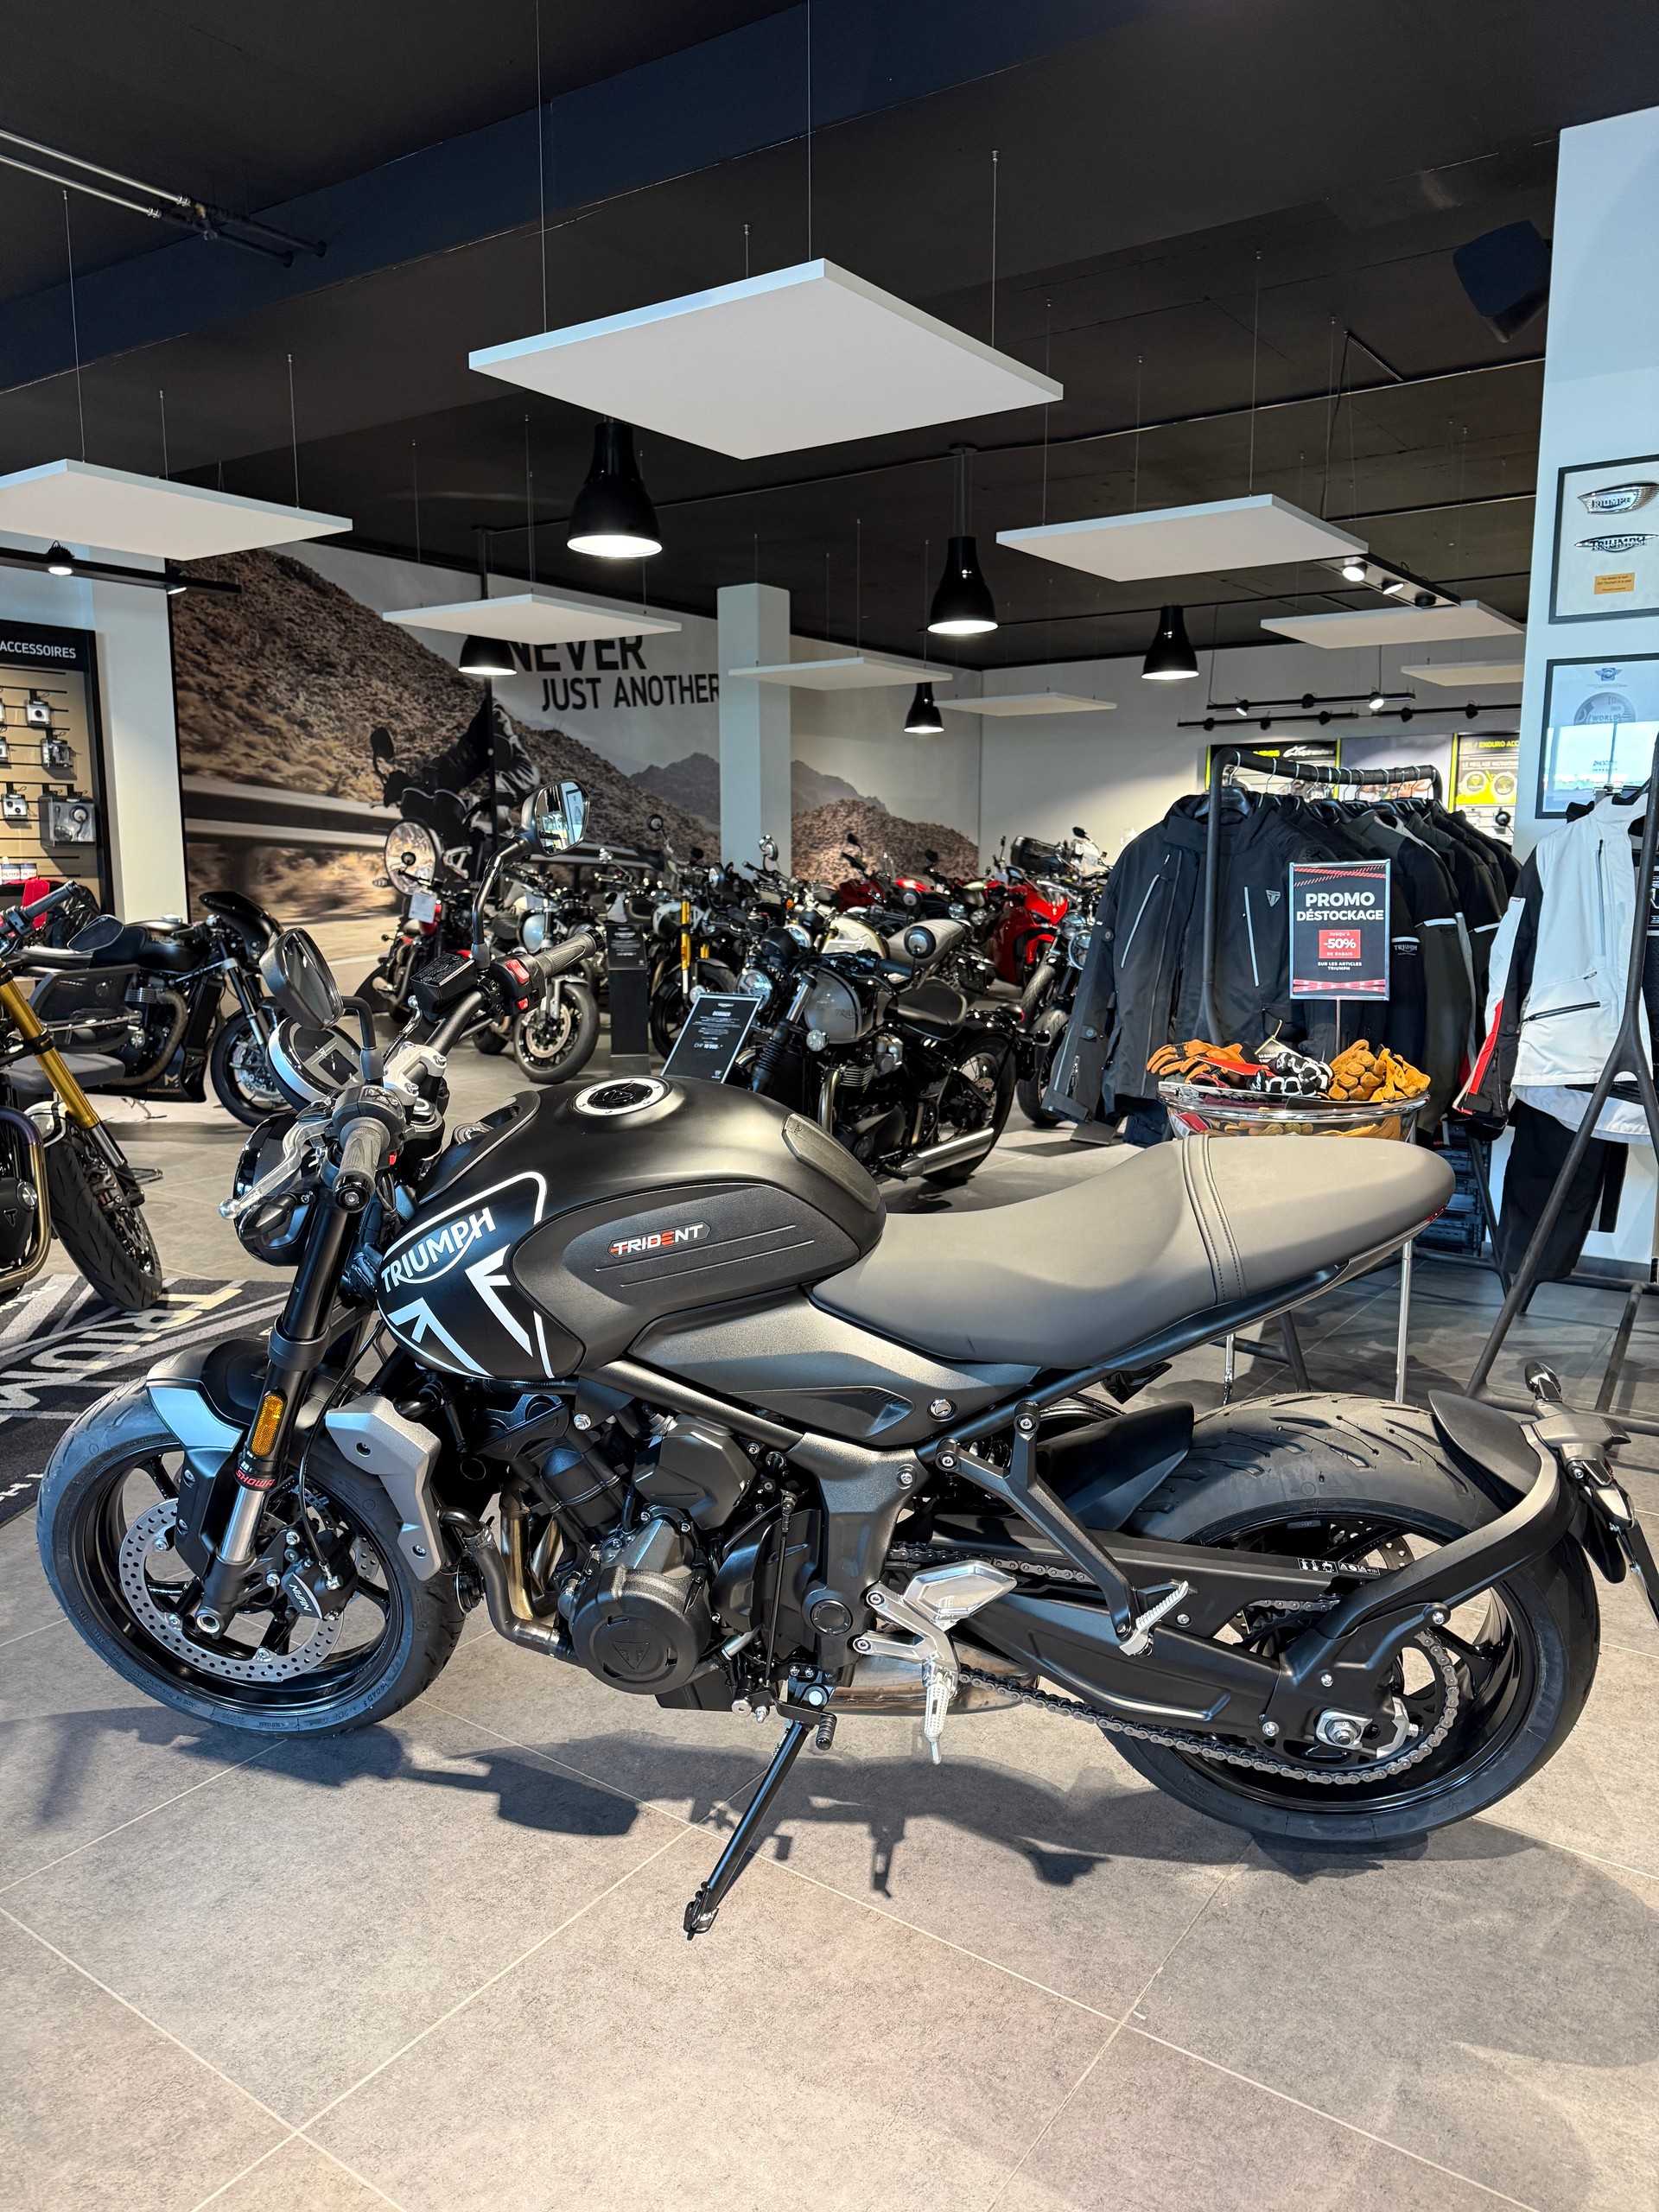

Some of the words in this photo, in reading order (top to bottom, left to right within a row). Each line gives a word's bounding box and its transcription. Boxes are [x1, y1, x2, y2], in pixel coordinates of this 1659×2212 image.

[0, 640, 77, 659] ACCESSOIRES
[542, 677, 602, 711] JUST
[613, 674, 719, 708] ANOTHER
[1305, 892, 1376, 907] PROMO
[1296, 908, 1384, 921] DÉSTOCKAGE
[1323, 938, 1357, 949] -50%
[612, 1224, 703, 1255] TRIDENT
[380, 1206, 497, 1294] TRIUMPH
[236, 1469, 276, 1488] SHOWA
